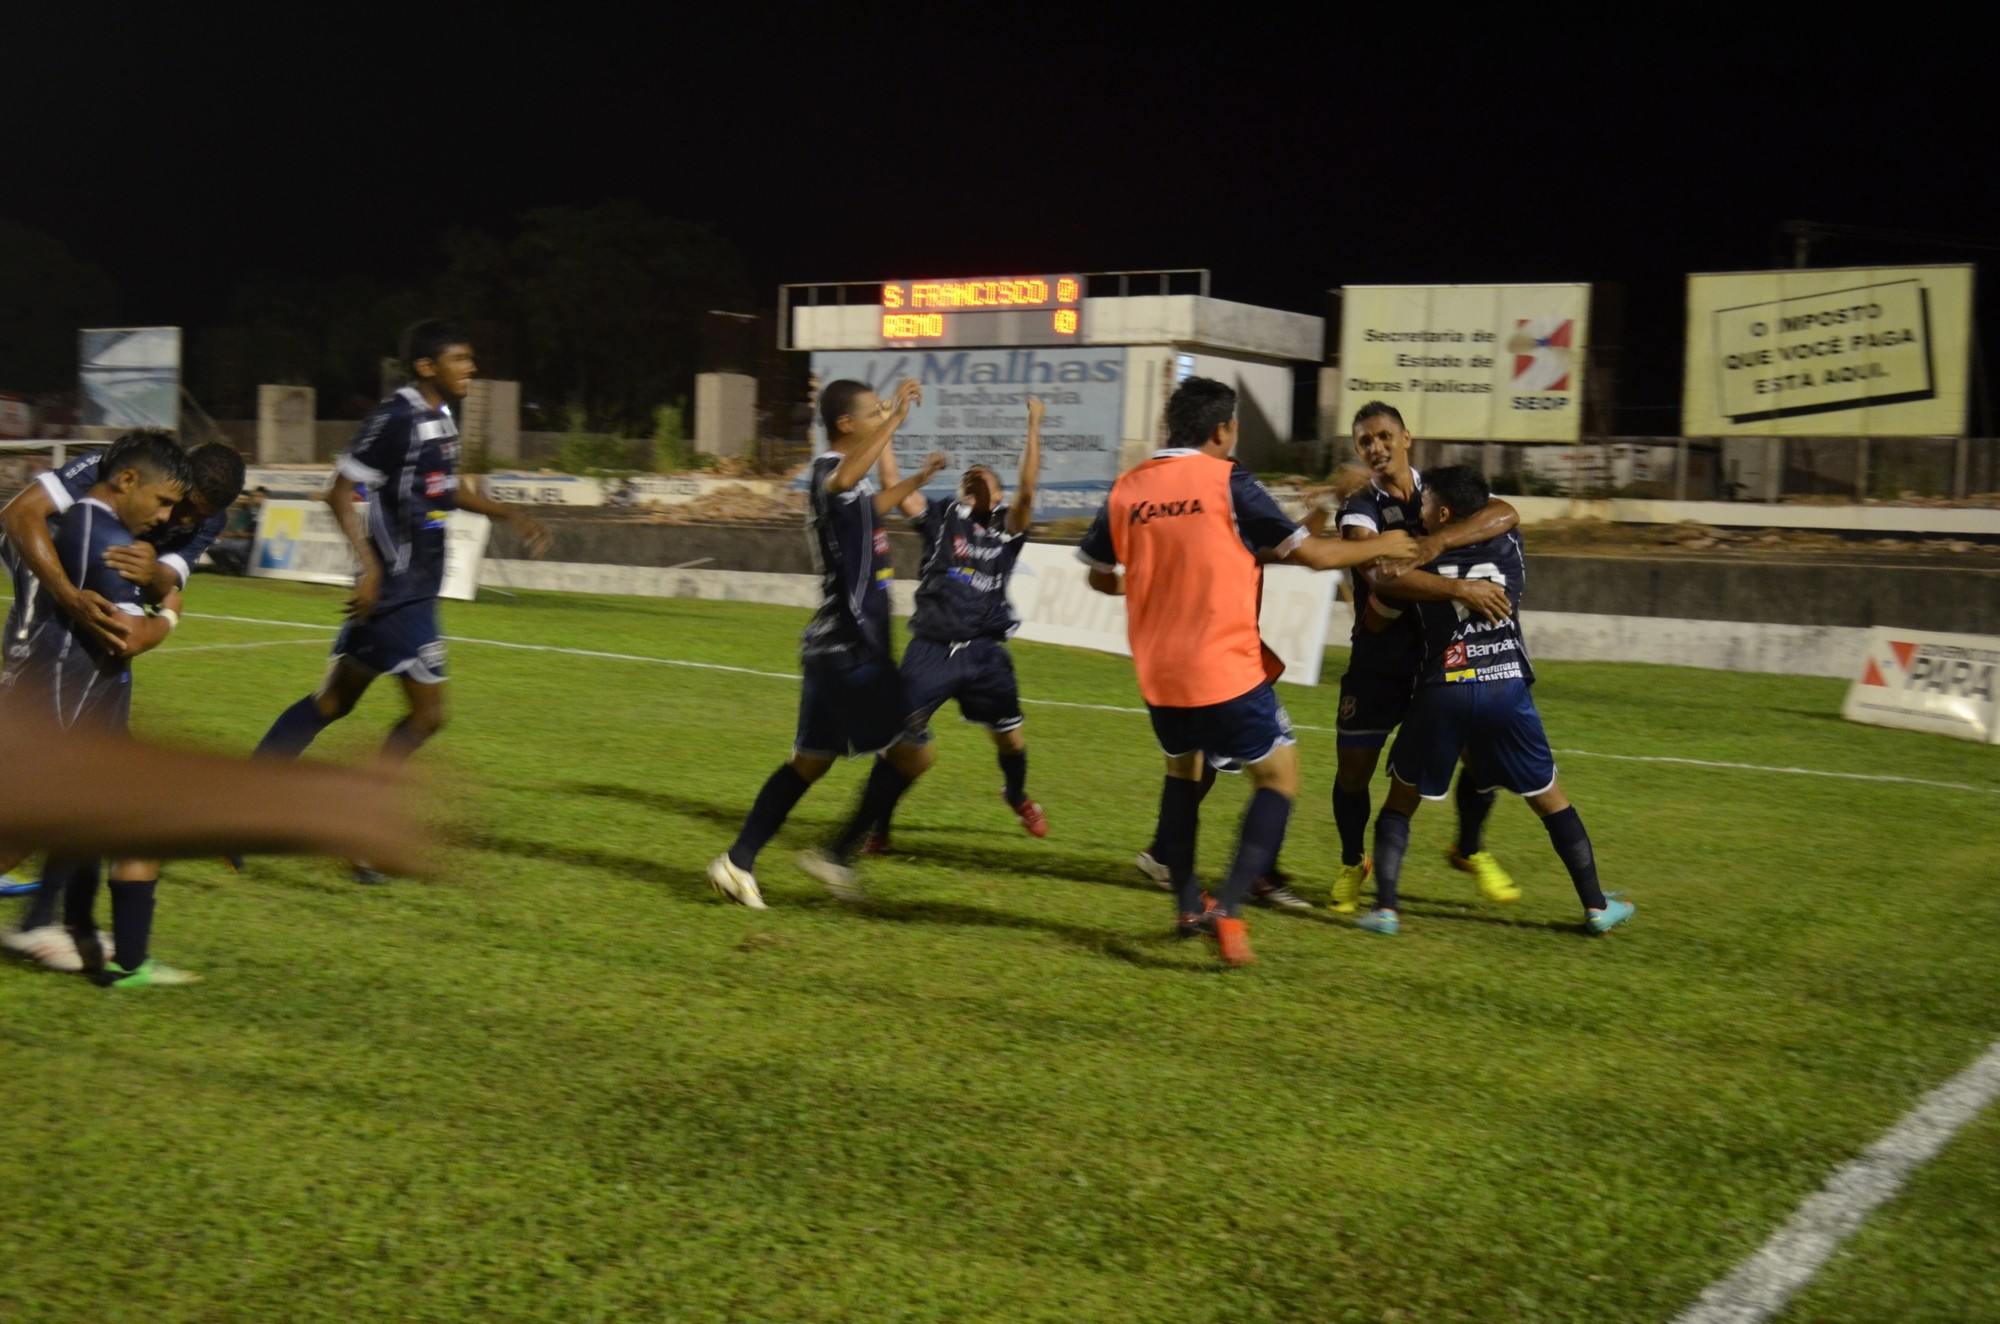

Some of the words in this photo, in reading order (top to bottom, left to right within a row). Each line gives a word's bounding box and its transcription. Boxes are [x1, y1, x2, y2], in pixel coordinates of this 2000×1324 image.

[911, 279, 1049, 308] FRANCISCO
[883, 313, 943, 337] REMO
[1750, 322, 1769, 337] O
[1777, 303, 1882, 333] IMPOSTO
[1364, 329, 1465, 342] Secretaria
[1470, 330, 1497, 343] de
[1396, 353, 1464, 367] Estado
[1469, 355, 1495, 367] de
[1725, 350, 1773, 370] QUE
[1850, 329, 1915, 350] PAGA
[921, 351, 1124, 385] Malhas
[1347, 378, 1402, 391] Obras
[1511, 396, 1569, 410] SEOP
[1129, 499, 1205, 527] KANXA
